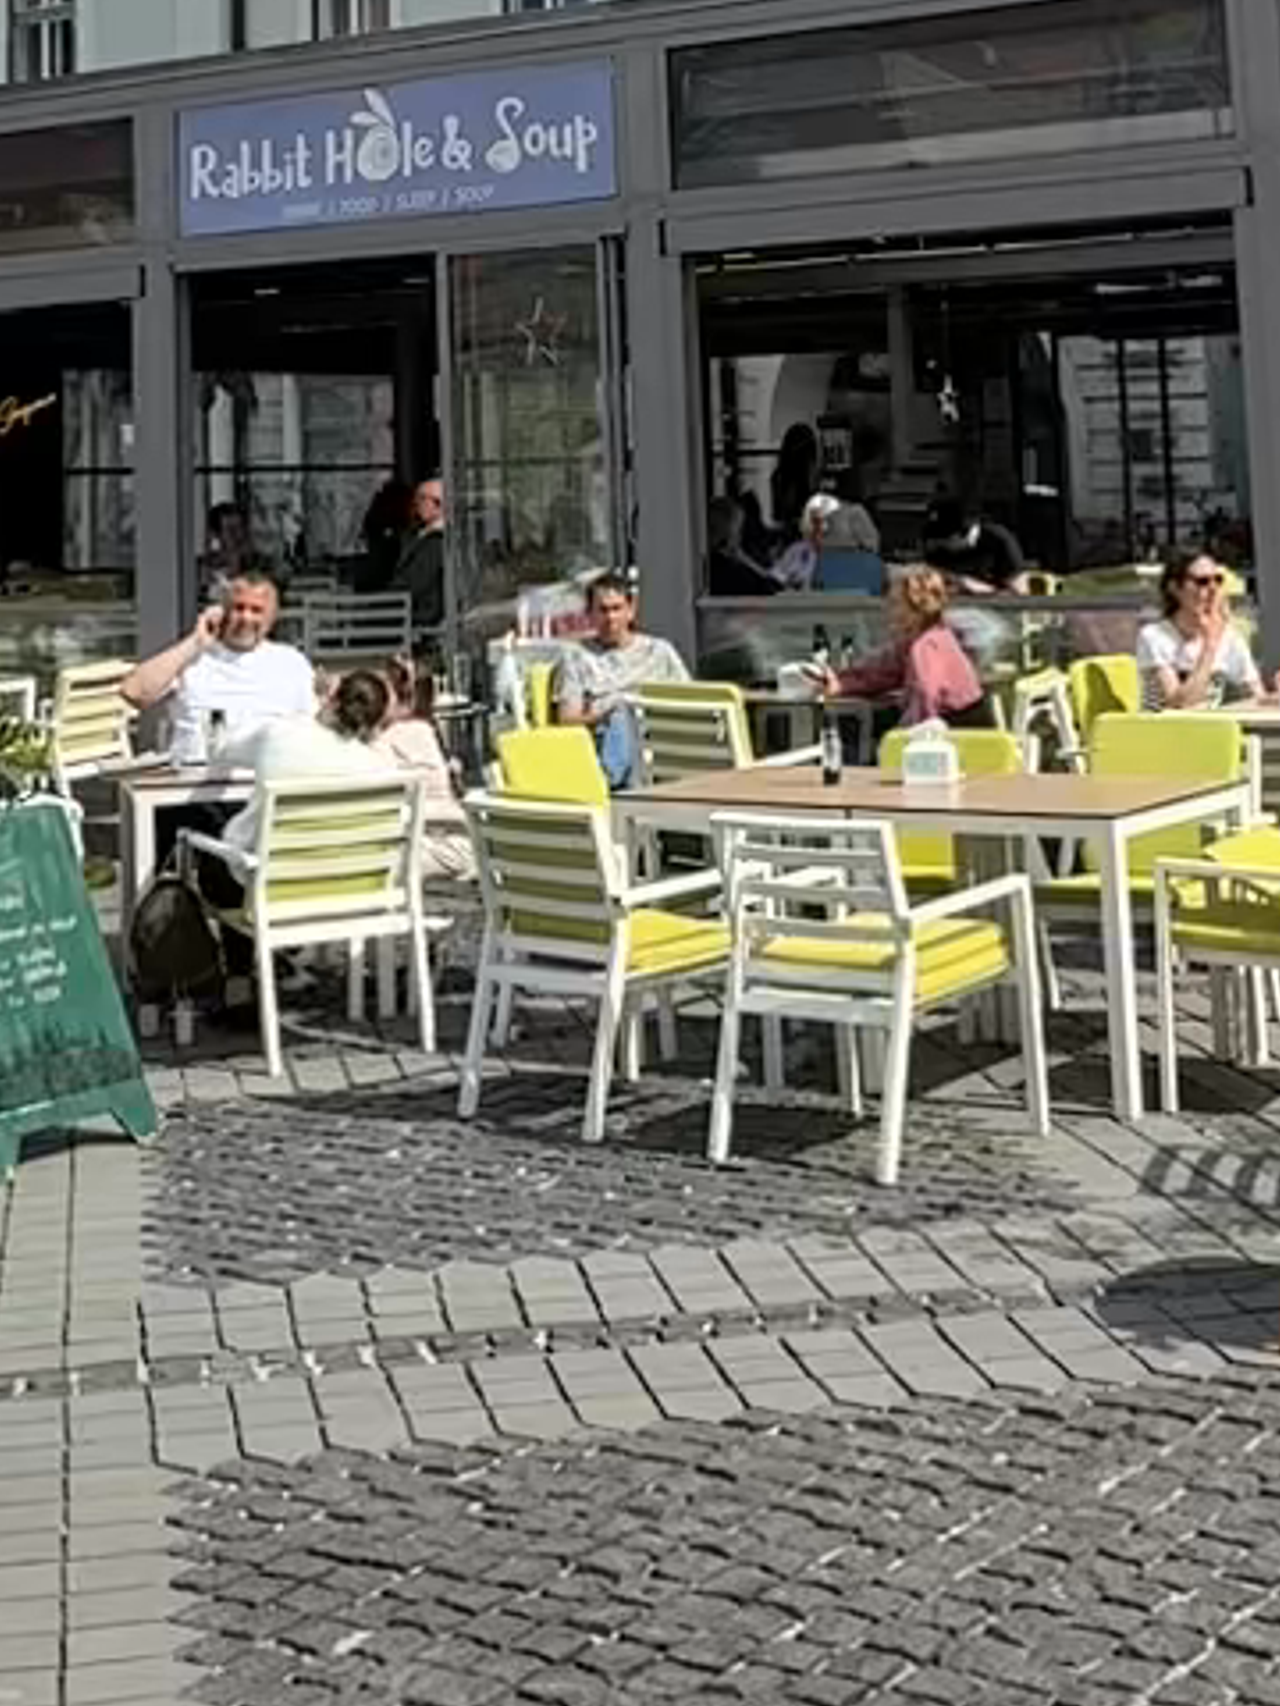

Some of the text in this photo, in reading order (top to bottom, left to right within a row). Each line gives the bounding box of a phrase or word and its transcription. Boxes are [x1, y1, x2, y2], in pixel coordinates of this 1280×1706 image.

[190, 88, 598, 199] Rabbit Hole & Soup
